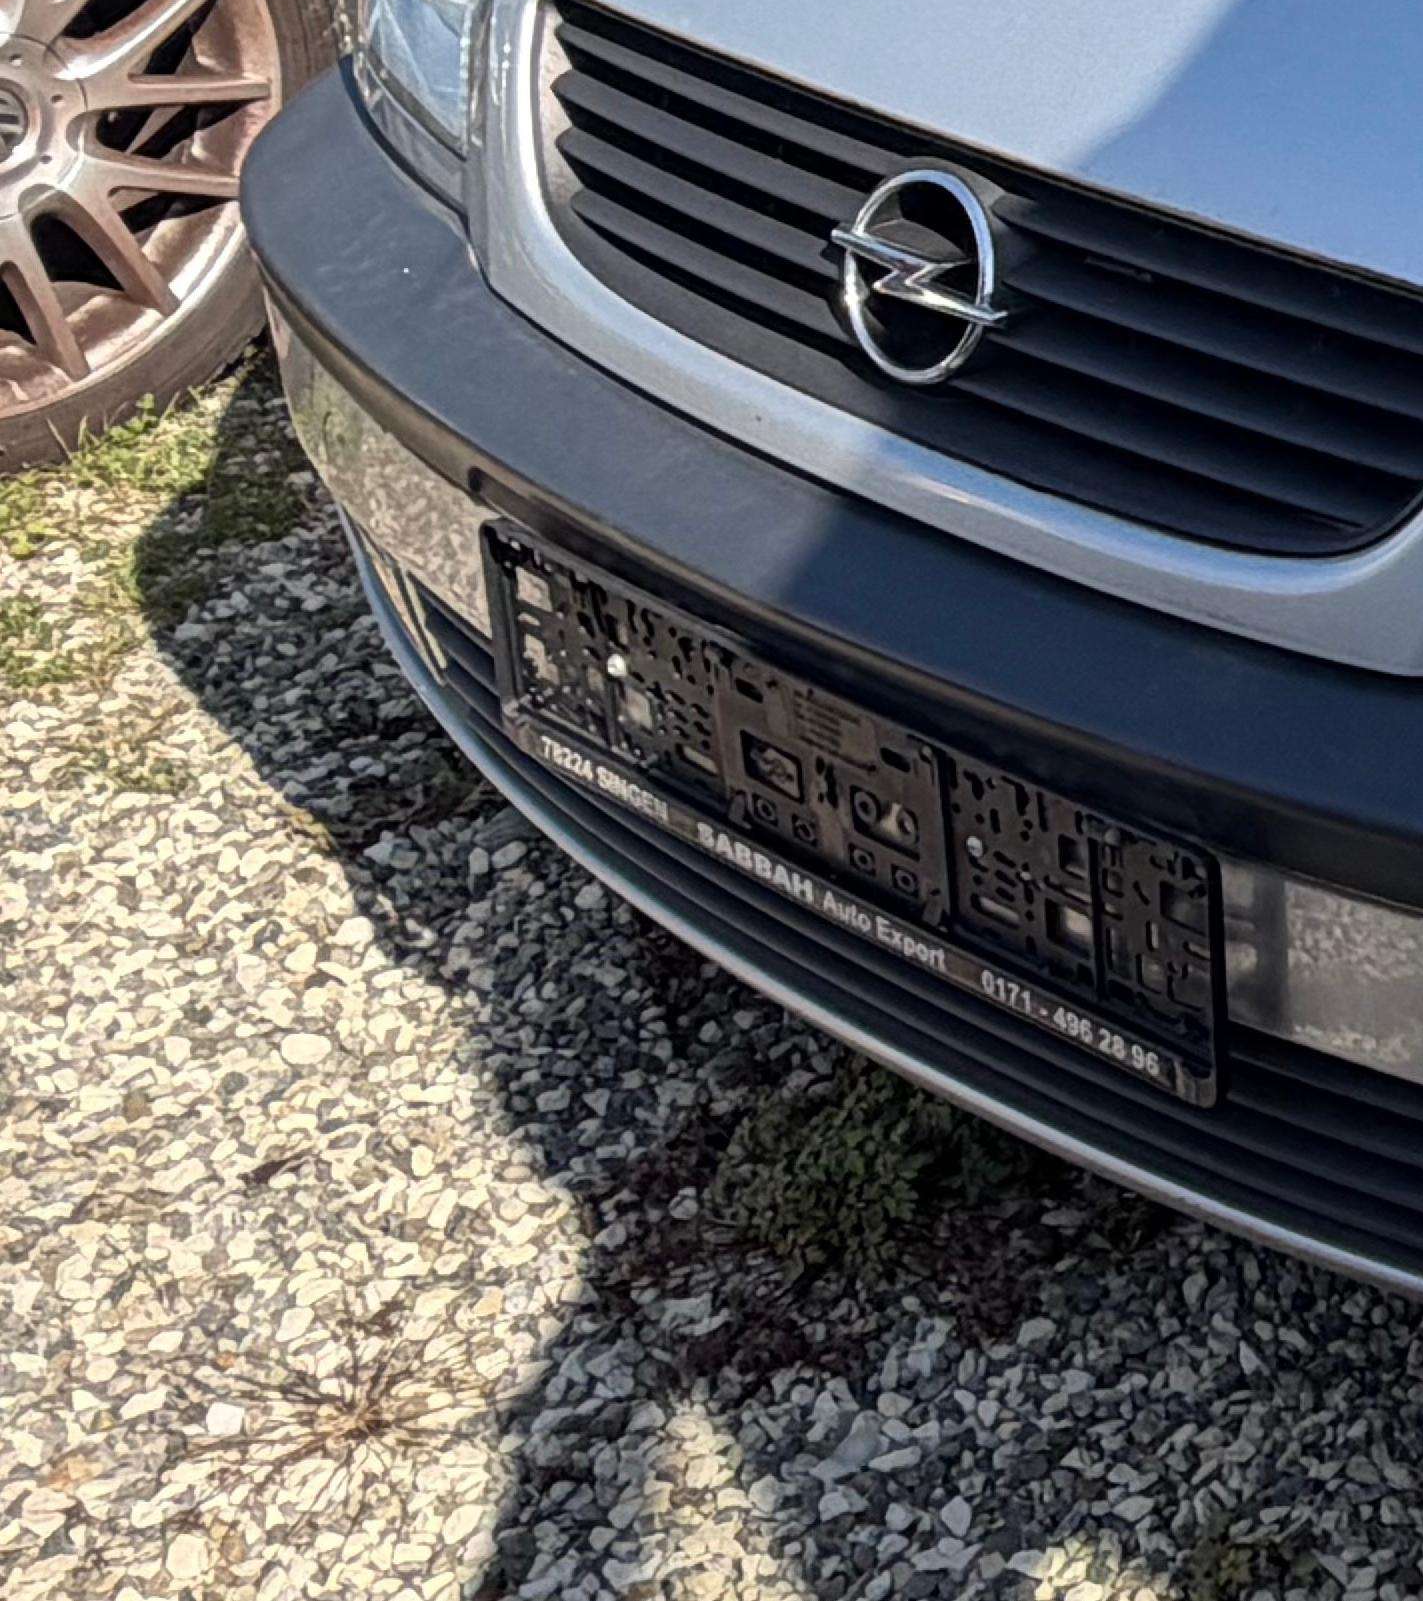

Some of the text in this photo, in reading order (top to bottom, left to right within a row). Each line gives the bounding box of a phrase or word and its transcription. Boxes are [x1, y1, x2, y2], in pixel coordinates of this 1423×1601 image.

[595, 765, 670, 821] SINGEN
[696, 821, 815, 905] SABBAH
[822, 890, 872, 932] Auto
[875, 915, 948, 972] Export
[980, 969, 1032, 1015] 0171
[1052, 1006, 1094, 1044] 496
[1098, 1027, 1128, 1060] 28
[1131, 1043, 1160, 1076] 96
